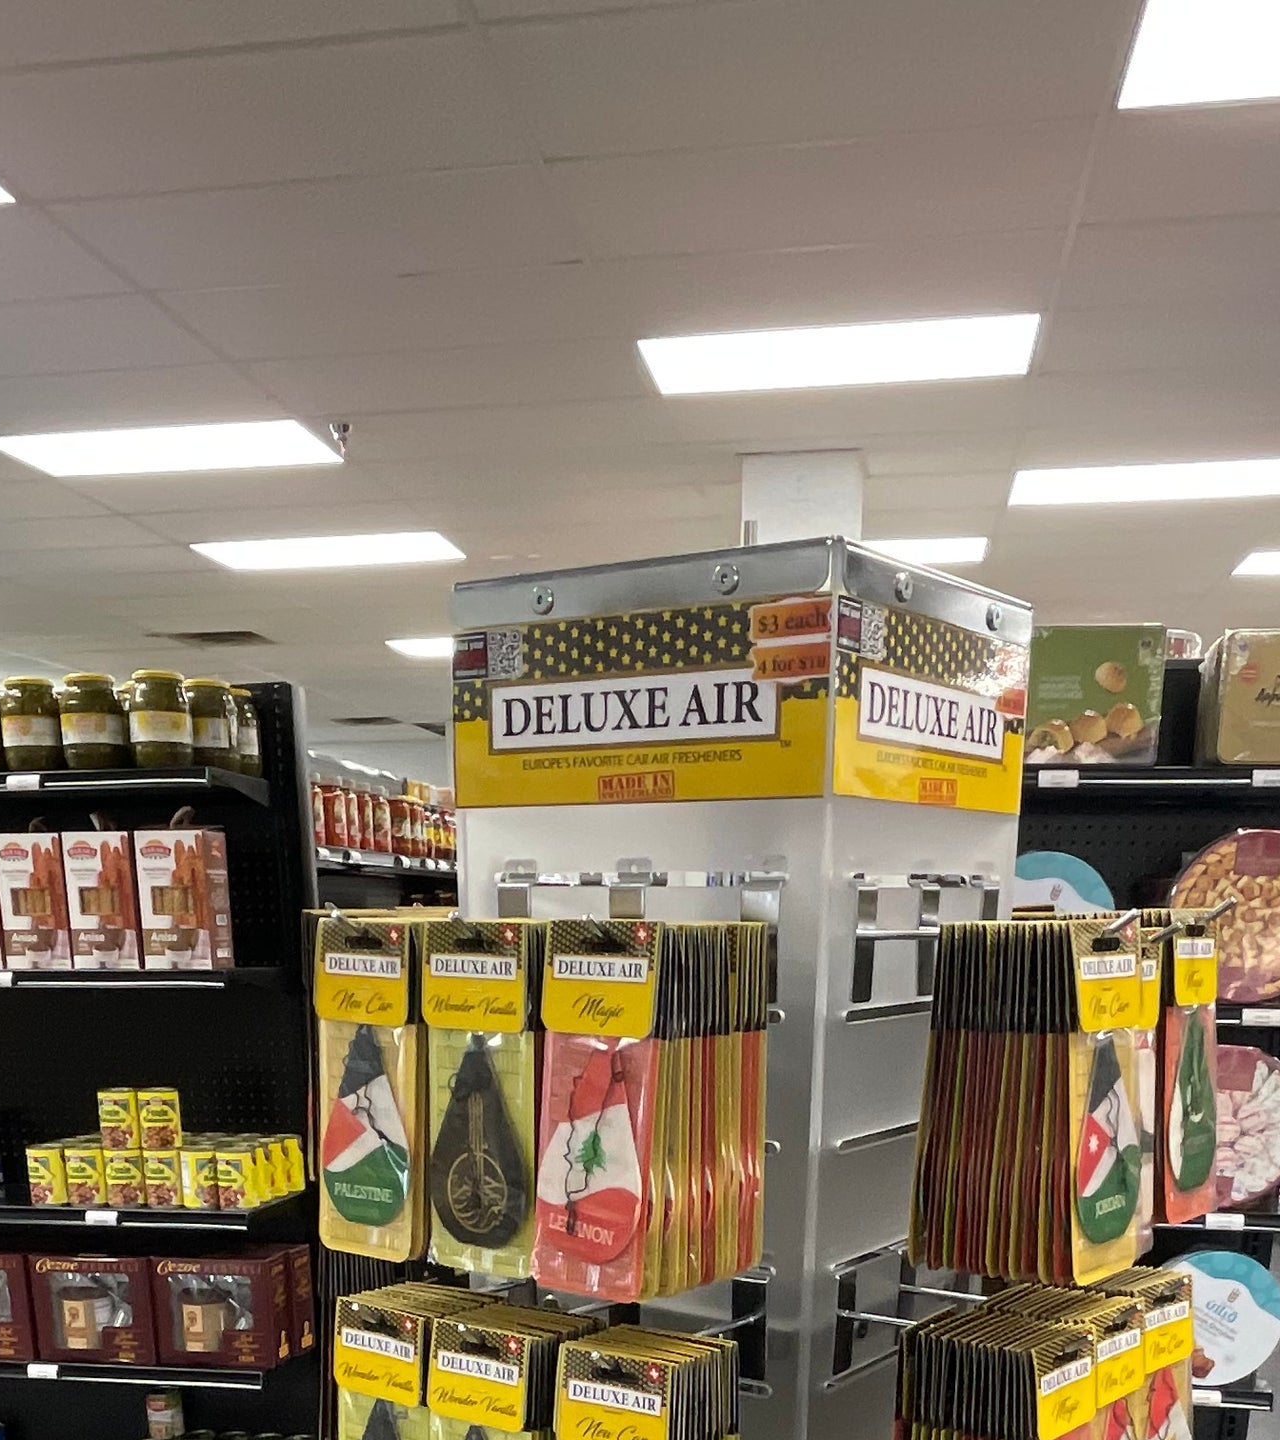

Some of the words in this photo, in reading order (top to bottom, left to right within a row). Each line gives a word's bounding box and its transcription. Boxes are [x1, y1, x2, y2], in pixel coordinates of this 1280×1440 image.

[758, 614, 779, 634] $3
[785, 606, 827, 630] each
[758, 660, 767, 675] 4
[772, 655, 794, 672] for
[502, 686, 671, 738] DELUXE
[678, 680, 764, 727] AIR
[867, 681, 959, 740] DELUXE
[962, 706, 998, 747] AIR
[523, 757, 571, 771] EUROPE'S
[573, 754, 624, 769] FAVORITE
[626, 753, 649, 766] CAR
[650, 752, 670, 765] AIR
[672, 749, 743, 765] FRESHENERS
[601, 775, 646, 792] MADE
[653, 773, 671, 789] IN
[328, 956, 378, 973] DELUXE
[379, 960, 398, 974] AIR
[434, 958, 489, 975] DELUXE
[490, 961, 513, 977] AIR
[557, 959, 617, 978] DELUXE
[620, 963, 645, 979] AIR
[1082, 958, 1115, 977] DELUXE
[1115, 957, 1134, 975] AIR
[332, 989, 363, 1011] New
[366, 991, 393, 1013] Car
[427, 995, 476, 1014] Wonder
[478, 997, 518, 1017] Vanilla
[573, 993, 624, 1028] Magic
[334, 1182, 394, 1204] PALESTINE
[548, 1212, 615, 1247] LEANON
[344, 1332, 391, 1354] DELUXE
[392, 1343, 411, 1360] AIR
[1124, 1331, 1139, 1349] AIR
[441, 1355, 494, 1377] DELUXE
[494, 1364, 516, 1382] AIR
[1042, 1365, 1072, 1392] DELUXE
[1072, 1360, 1091, 1379] AIR
[572, 1383, 631, 1407] DELUXE
[632, 1395, 658, 1413] AIR
[576, 1416, 612, 1440] New
